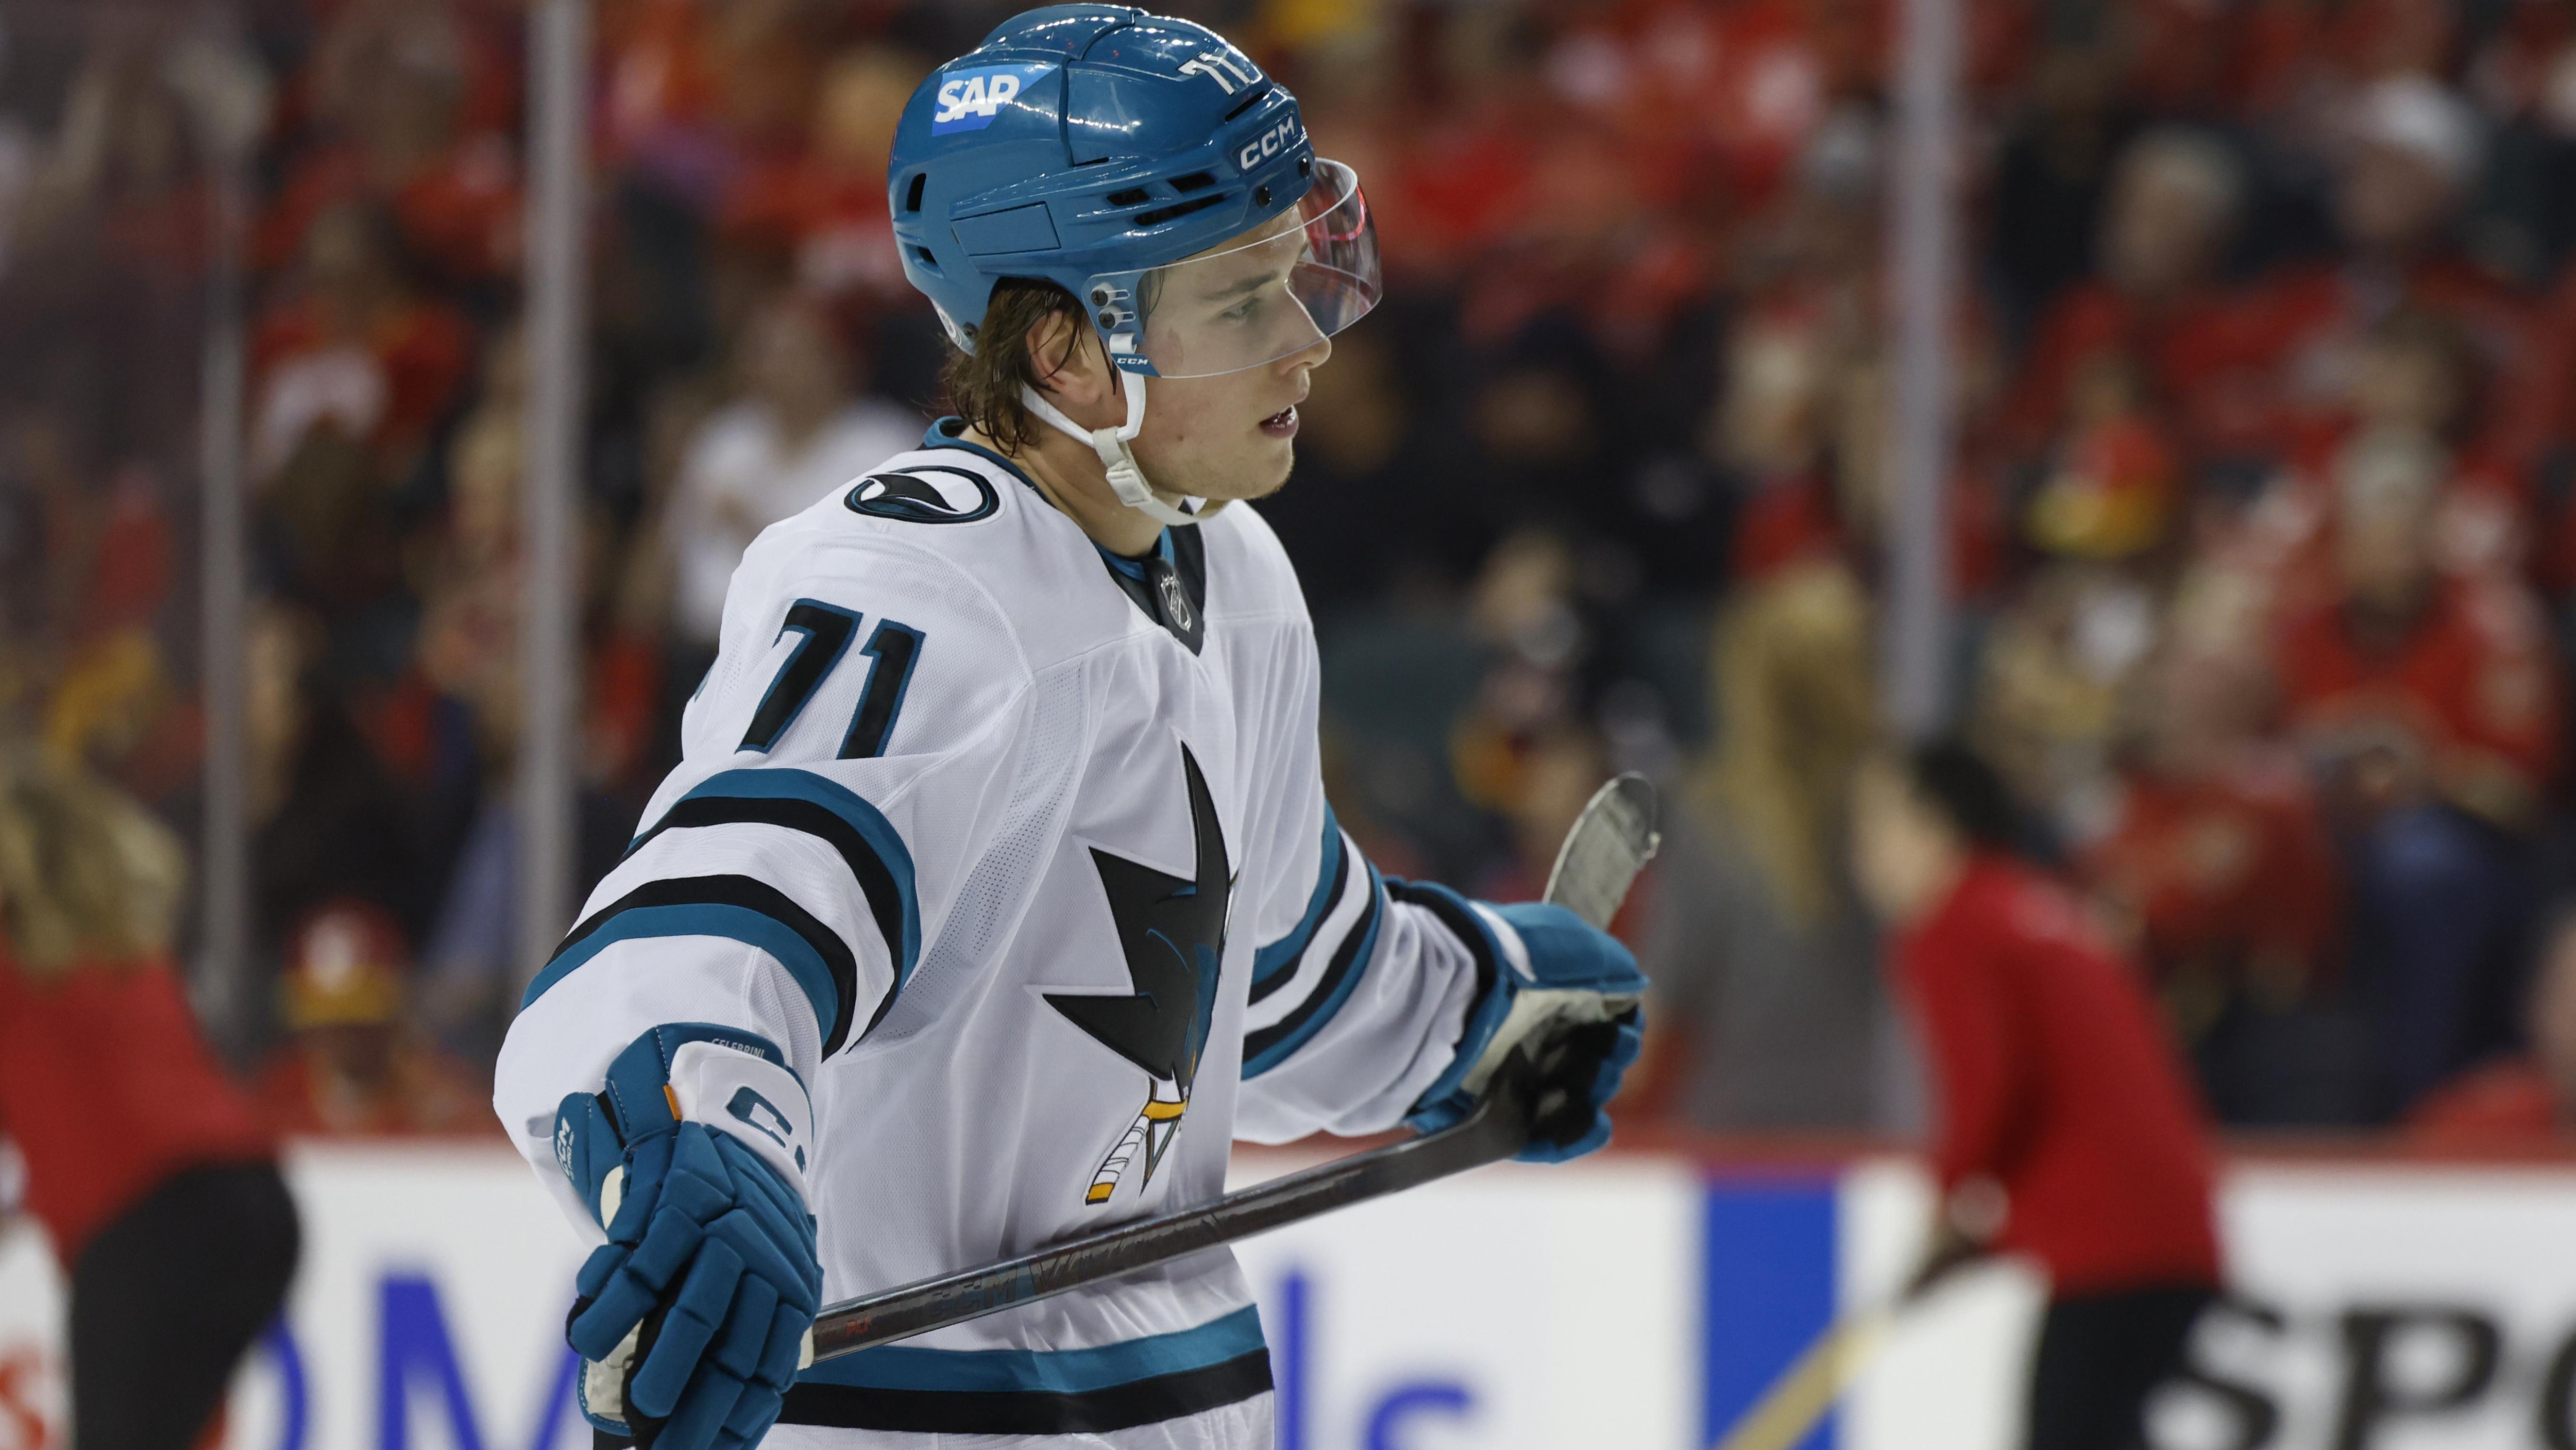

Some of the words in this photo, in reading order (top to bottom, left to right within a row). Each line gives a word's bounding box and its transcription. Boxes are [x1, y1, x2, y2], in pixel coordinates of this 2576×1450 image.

[935, 75, 1020, 123] SAP
[1177, 51, 1251, 96] 71
[1240, 115, 1295, 171] CCM
[734, 598, 926, 761] 71
[557, 1116, 571, 1176] CCM
